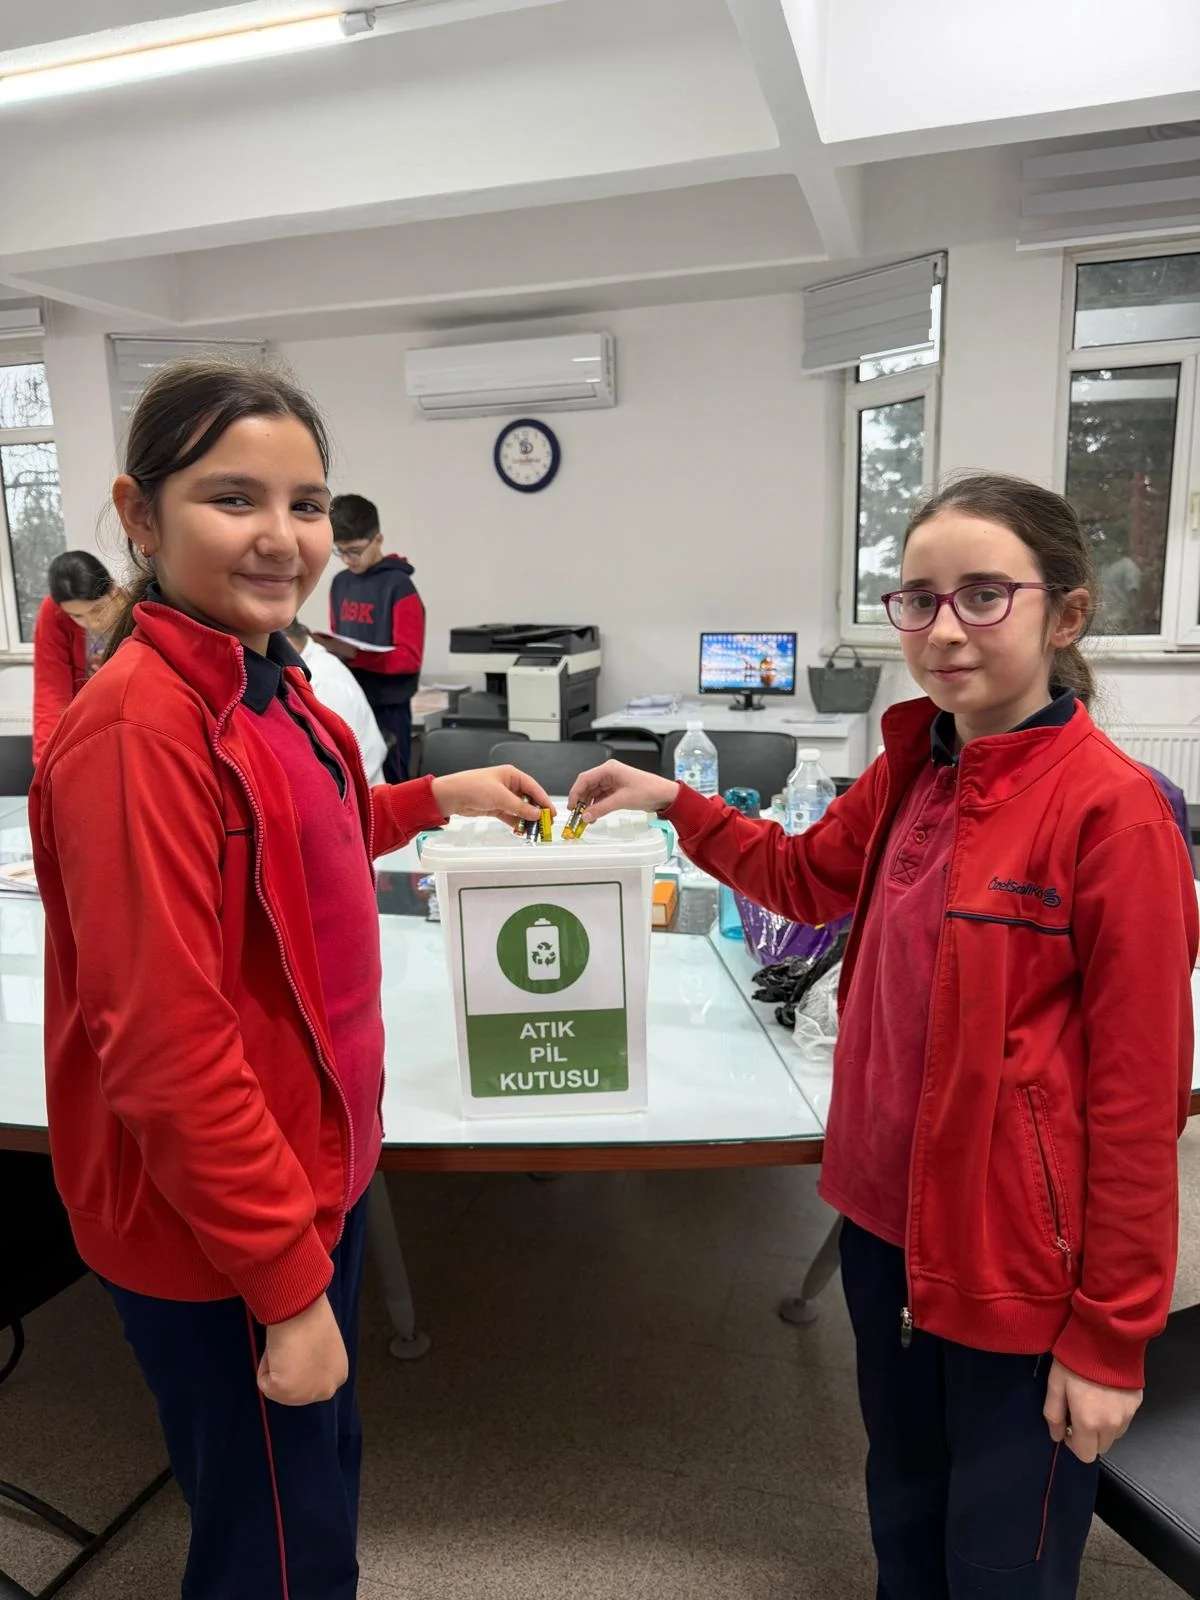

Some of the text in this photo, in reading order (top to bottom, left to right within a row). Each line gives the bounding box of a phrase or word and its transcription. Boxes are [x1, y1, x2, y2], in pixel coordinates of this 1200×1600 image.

[519, 1020, 575, 1040] ATIK
[530, 1043, 568, 1063] PİL
[500, 1069, 599, 1091] KUTUSU
